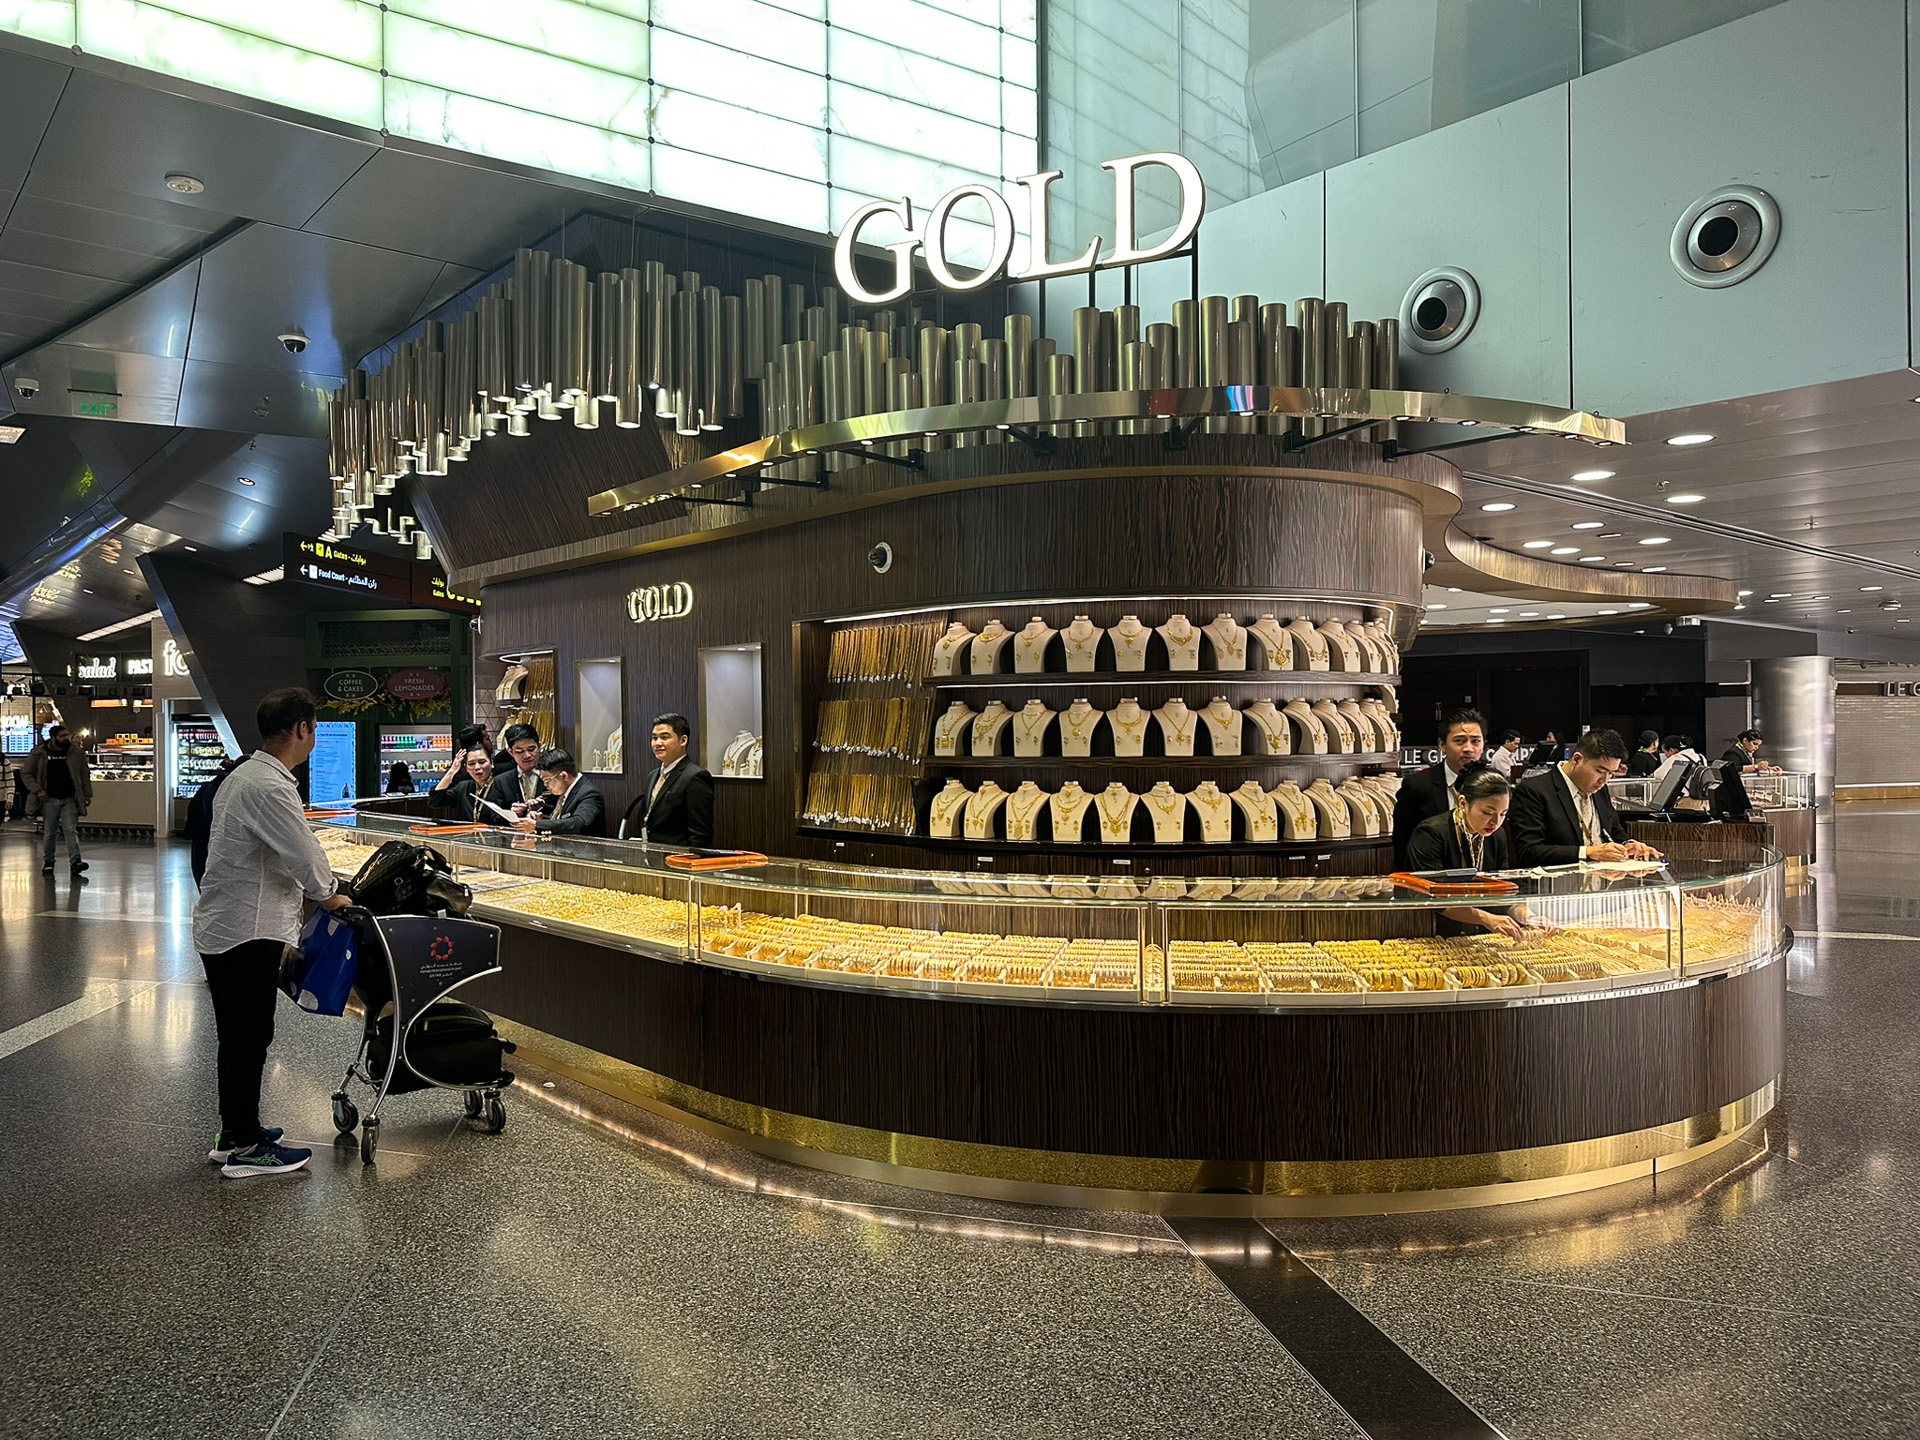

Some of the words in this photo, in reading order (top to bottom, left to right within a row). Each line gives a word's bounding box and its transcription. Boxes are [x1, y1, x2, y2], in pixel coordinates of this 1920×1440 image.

[834, 151, 1206, 304] GOLD
[79, 402, 109, 416] EXIT
[325, 546, 332, 559] A
[333, 550, 347, 560] Gates
[318, 569, 331, 579] Food
[332, 572, 345, 582] Court
[627, 582, 693, 623] GOLD
[78, 656, 117, 678] salad
[1887, 681, 1906, 697] LE
[1404, 750, 1421, 764] LE
